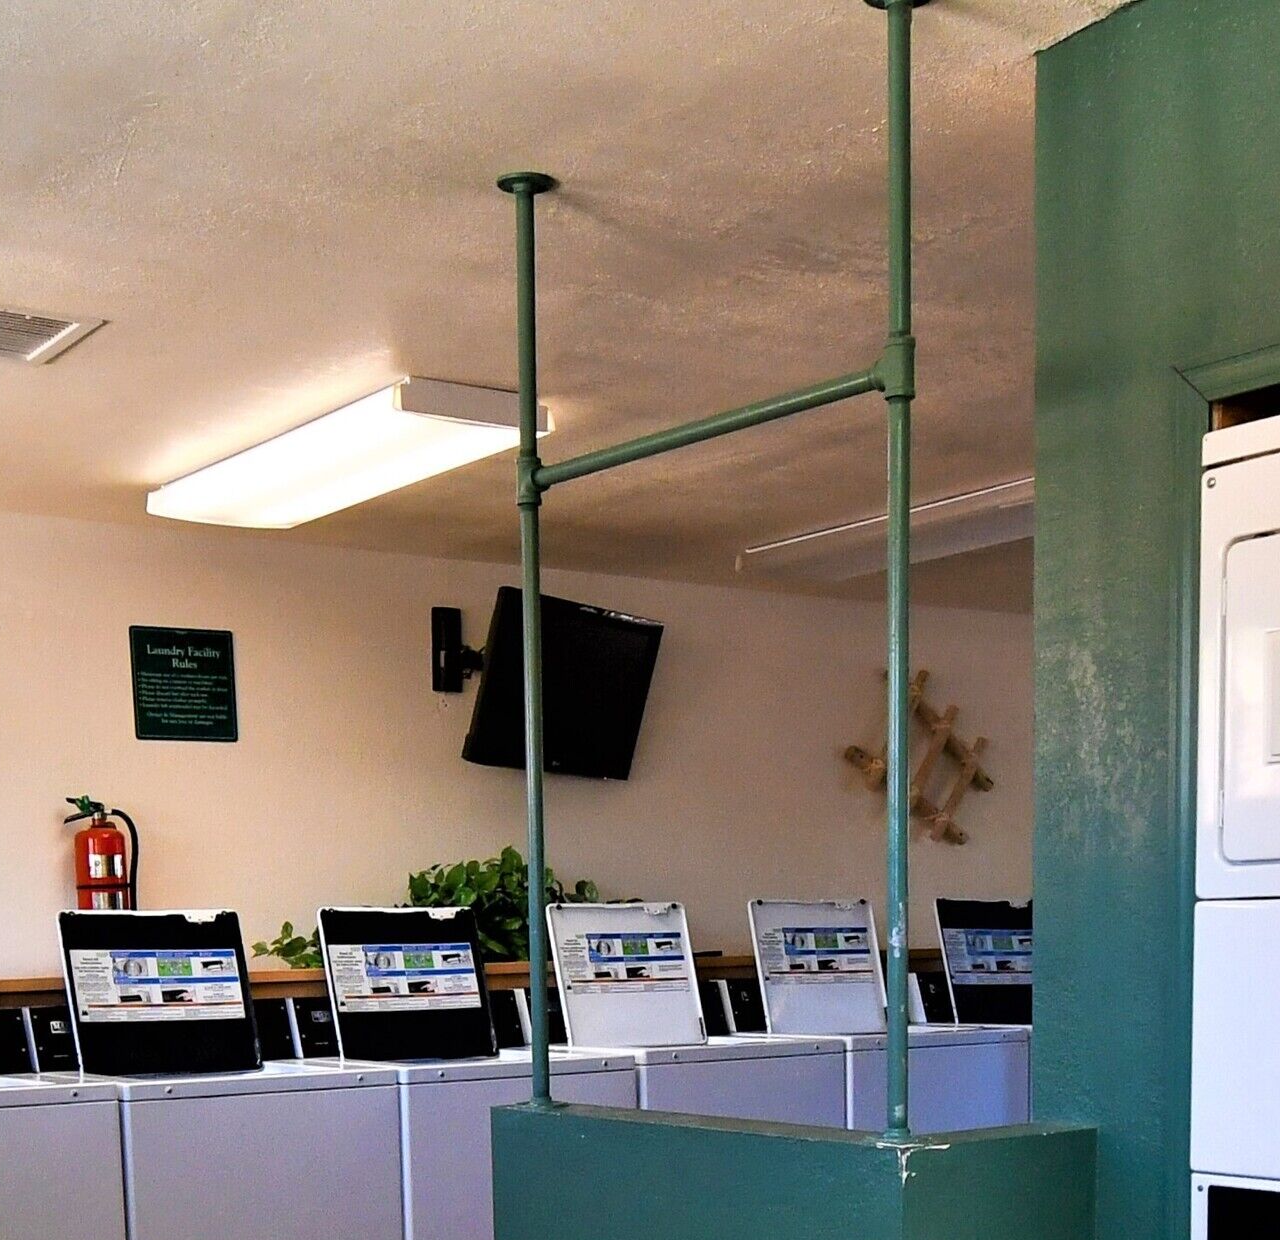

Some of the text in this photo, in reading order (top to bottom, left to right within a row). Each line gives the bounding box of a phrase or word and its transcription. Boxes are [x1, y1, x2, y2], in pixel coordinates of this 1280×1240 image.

[147, 644, 220, 659] Laundry Facility
[172, 658, 197, 669] Rules
